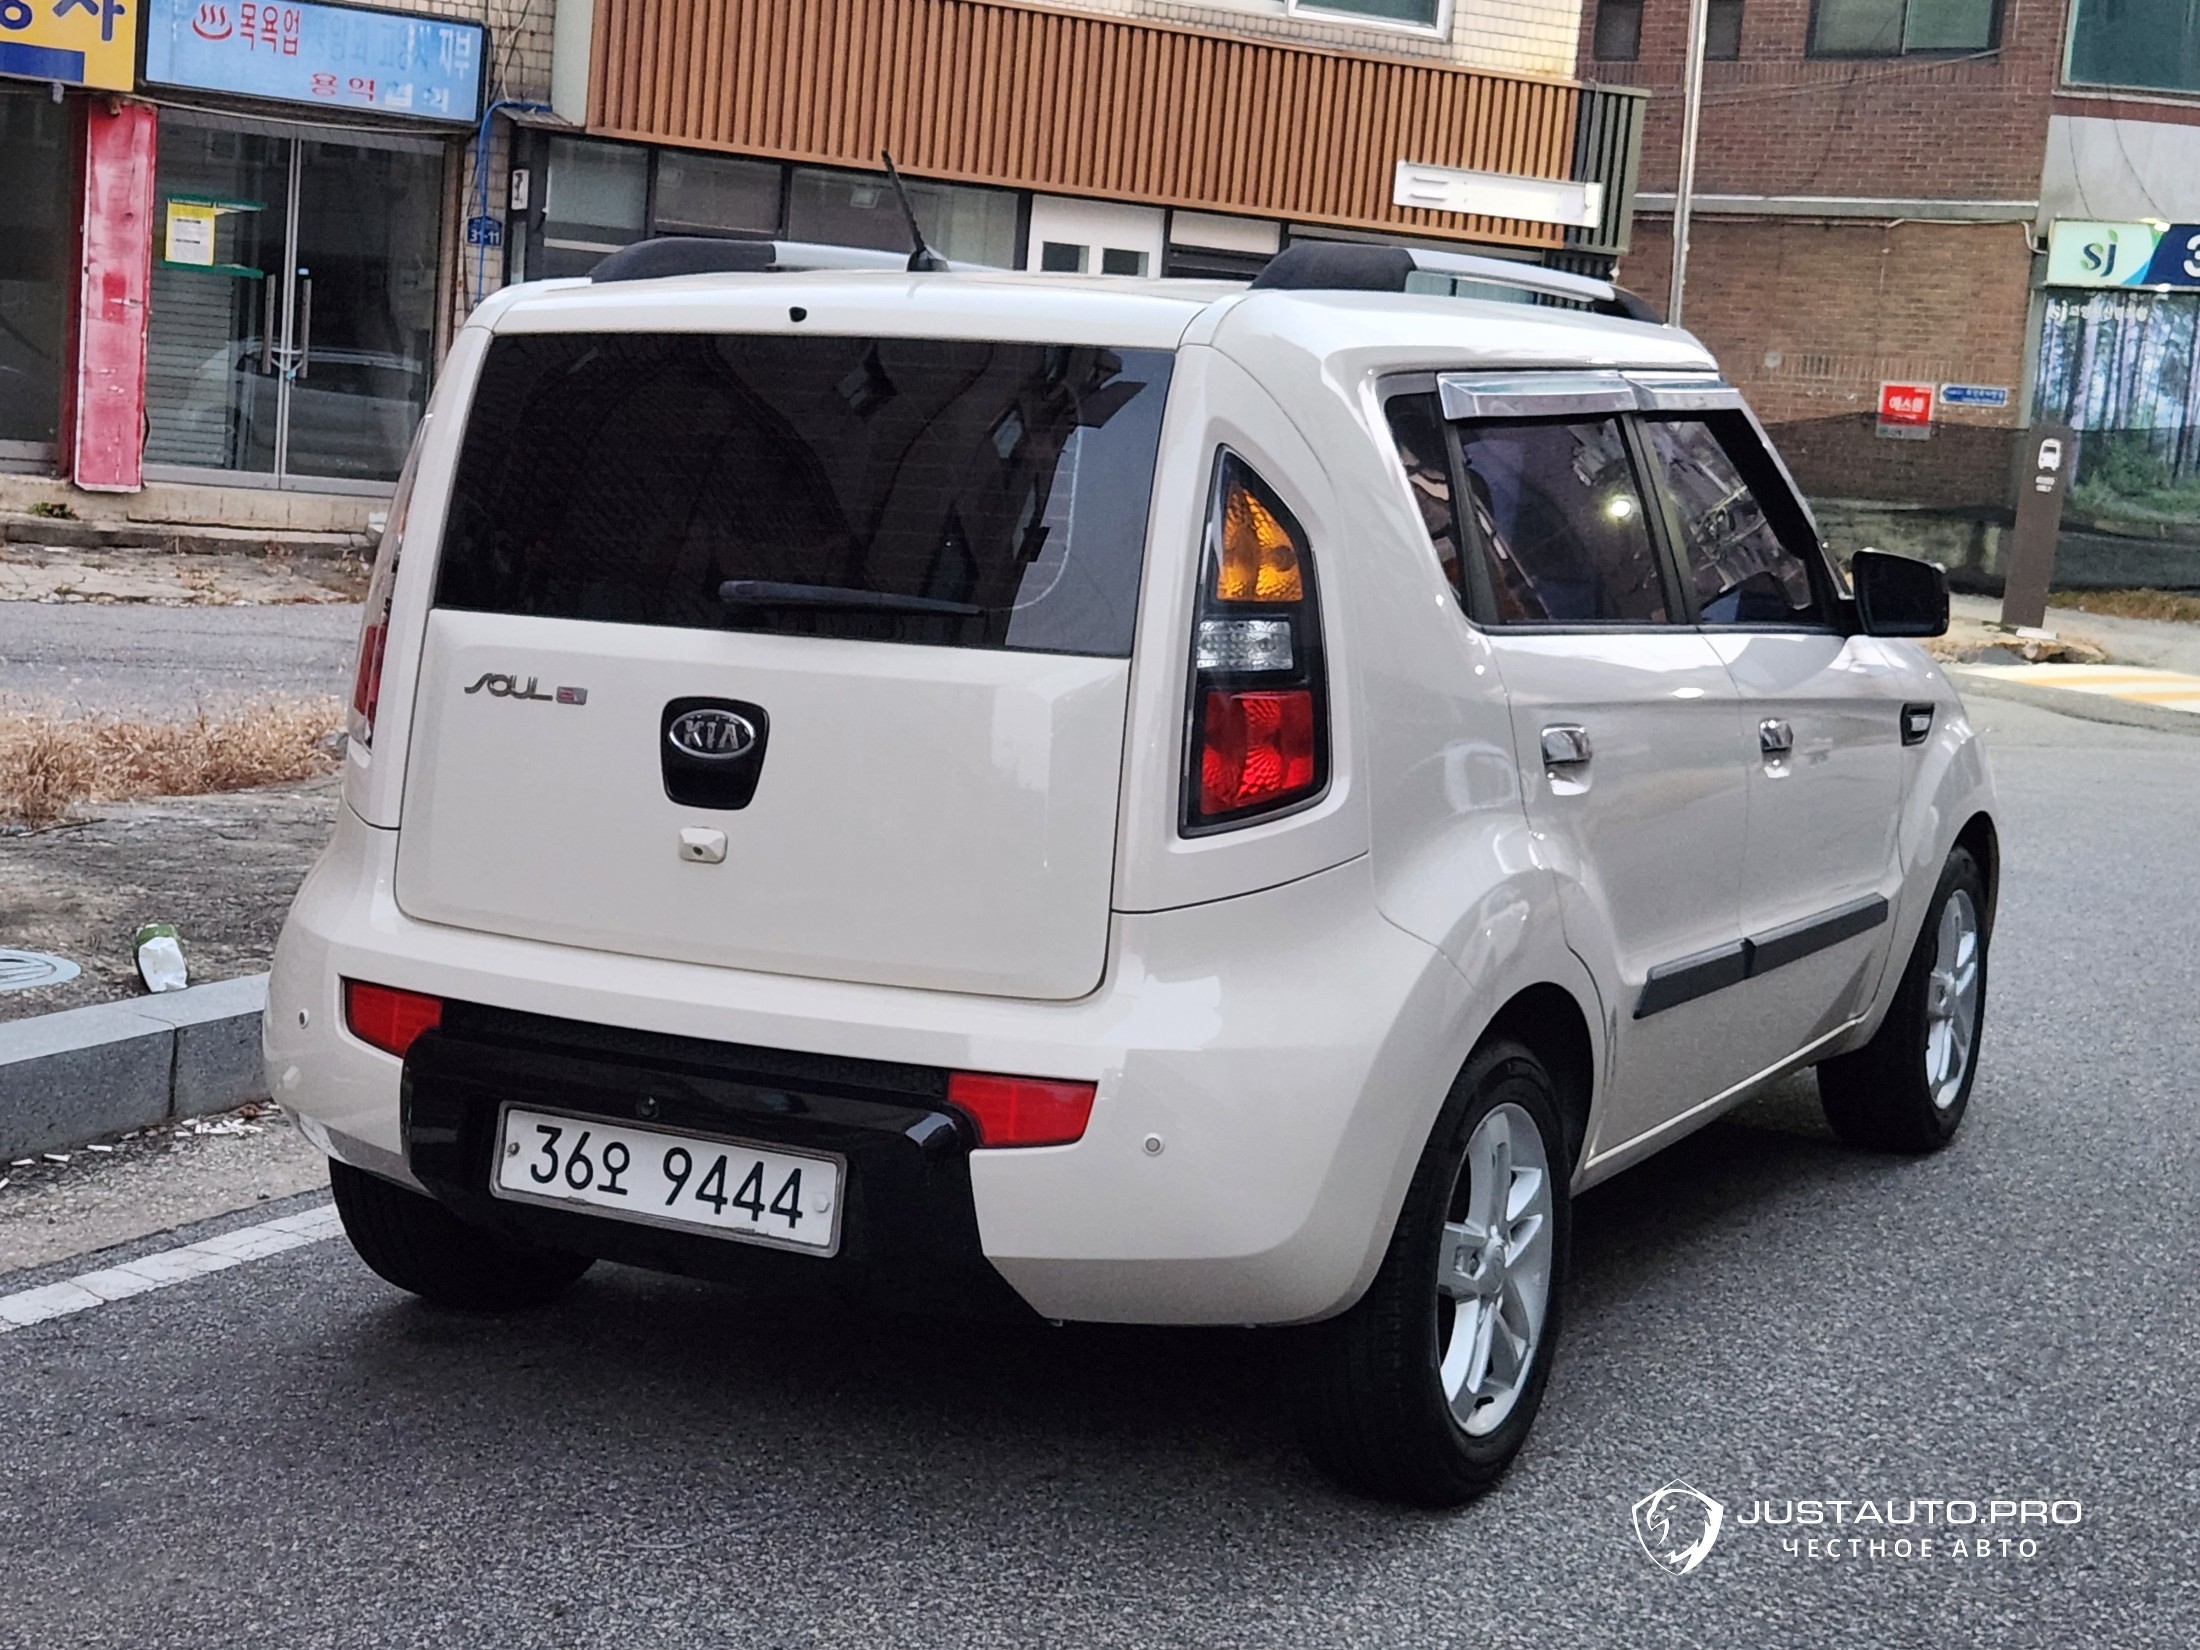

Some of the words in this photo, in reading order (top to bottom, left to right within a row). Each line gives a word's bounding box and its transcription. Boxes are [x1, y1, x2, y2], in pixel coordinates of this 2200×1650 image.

[683, 718, 740, 750] KIA
[530, 1124, 629, 1196] 36오
[662, 1146, 803, 1229] 9444
